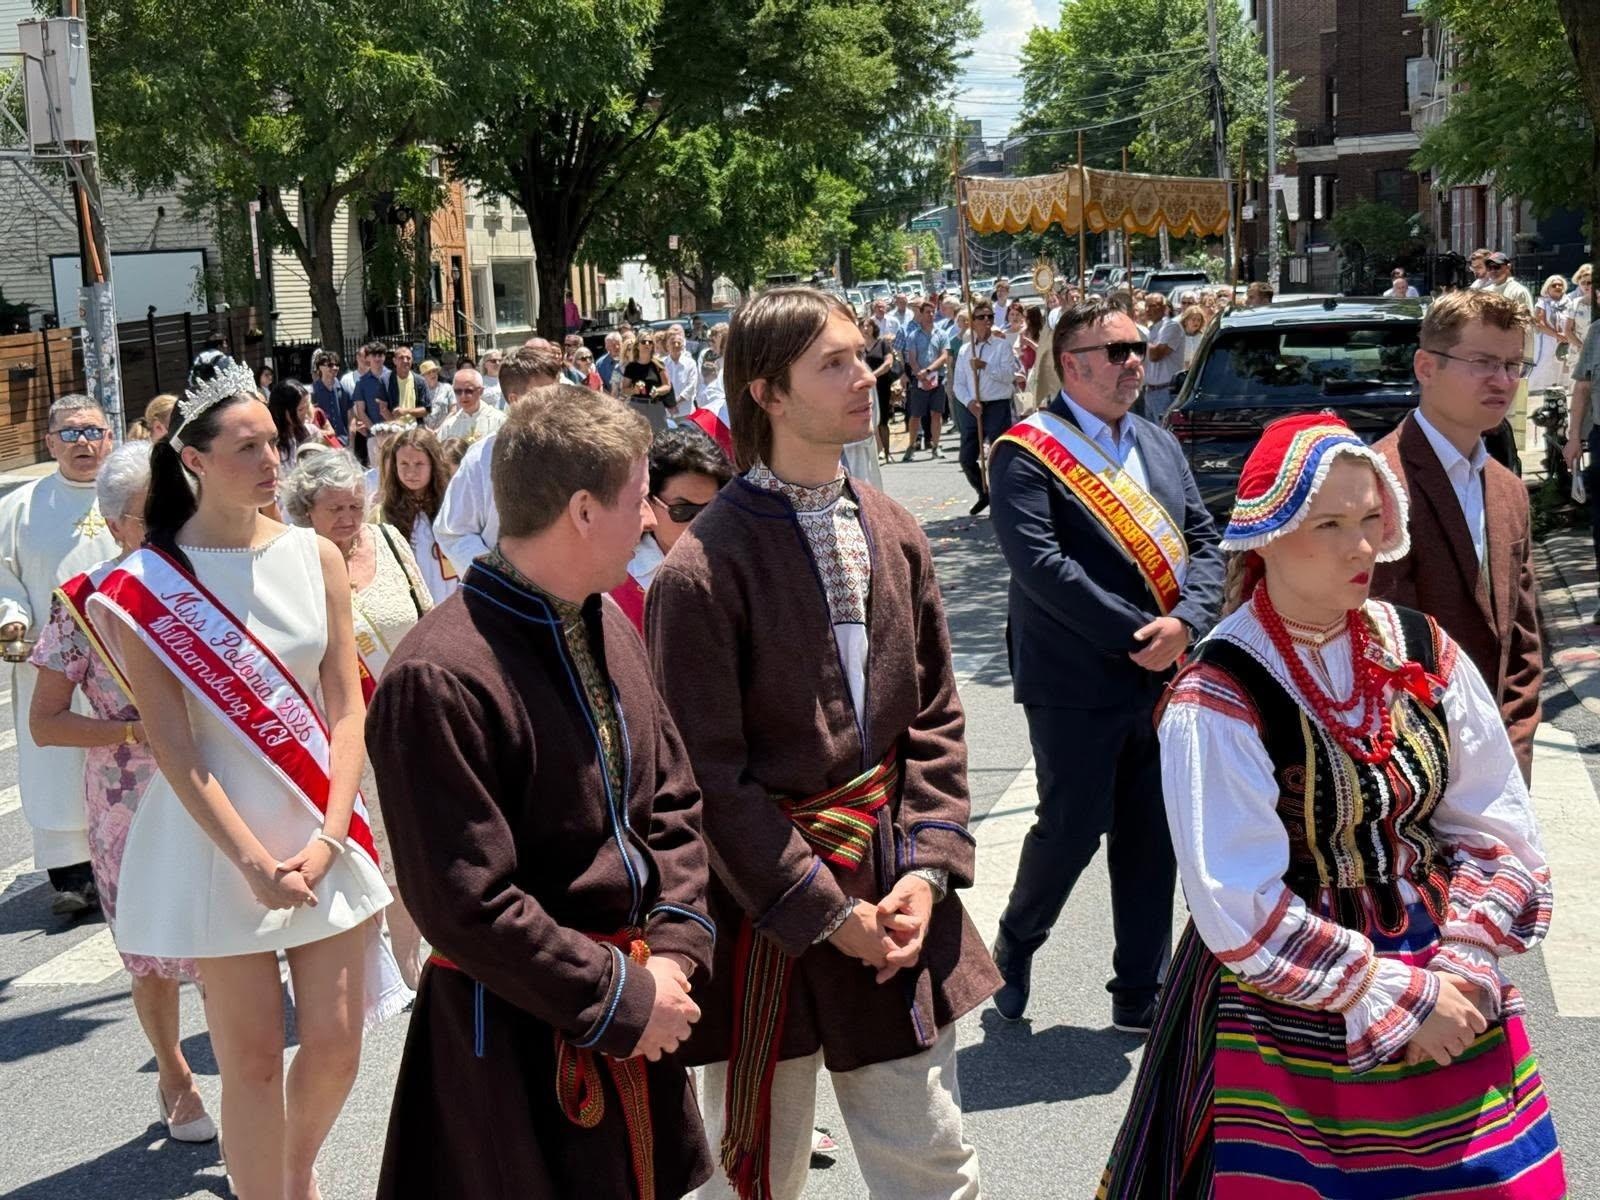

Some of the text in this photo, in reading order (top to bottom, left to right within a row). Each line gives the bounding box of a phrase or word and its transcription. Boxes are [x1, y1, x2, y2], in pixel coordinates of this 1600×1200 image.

[1070, 464, 1178, 597] WILLIAMSBURG, NY
[149, 614, 295, 748] Williamsburg, NY
[160, 591, 312, 743] Miss Polonia 2026
